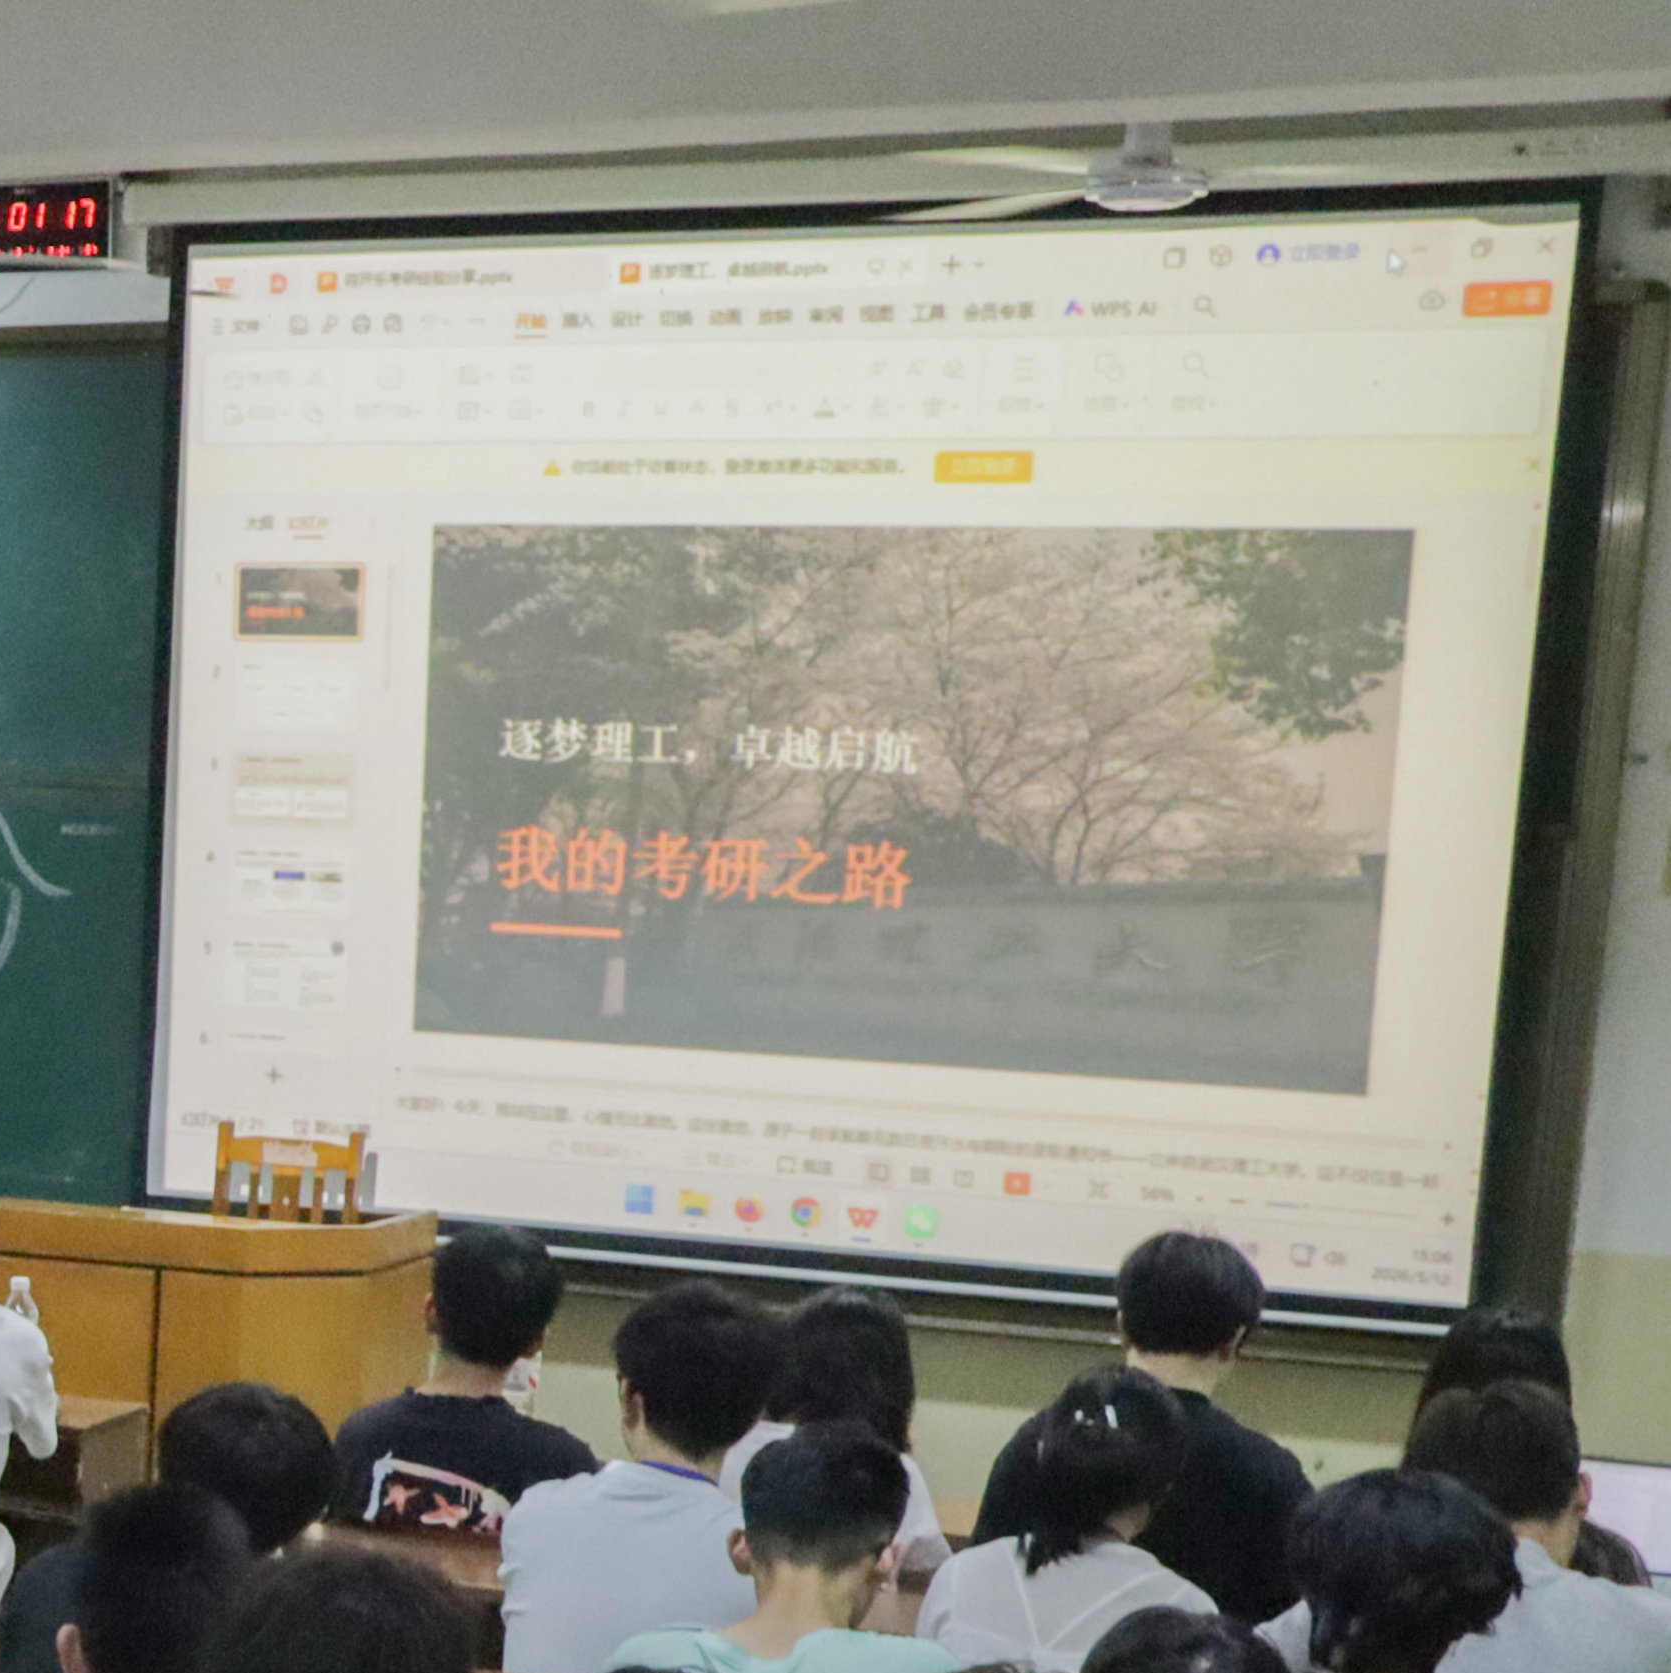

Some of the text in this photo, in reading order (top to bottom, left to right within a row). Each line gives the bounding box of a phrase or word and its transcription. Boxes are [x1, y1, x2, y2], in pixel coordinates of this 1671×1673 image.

[7, 201, 47, 232] 01
[65, 197, 97, 230] 17
[515, 312, 546, 330] 开始
[611, 310, 643, 328] 设计
[1090, 300, 1157, 318] WPS AI
[499, 717, 921, 775] 逐梦理工，卓越启航
[495, 824, 913, 911] 我的考研之路
